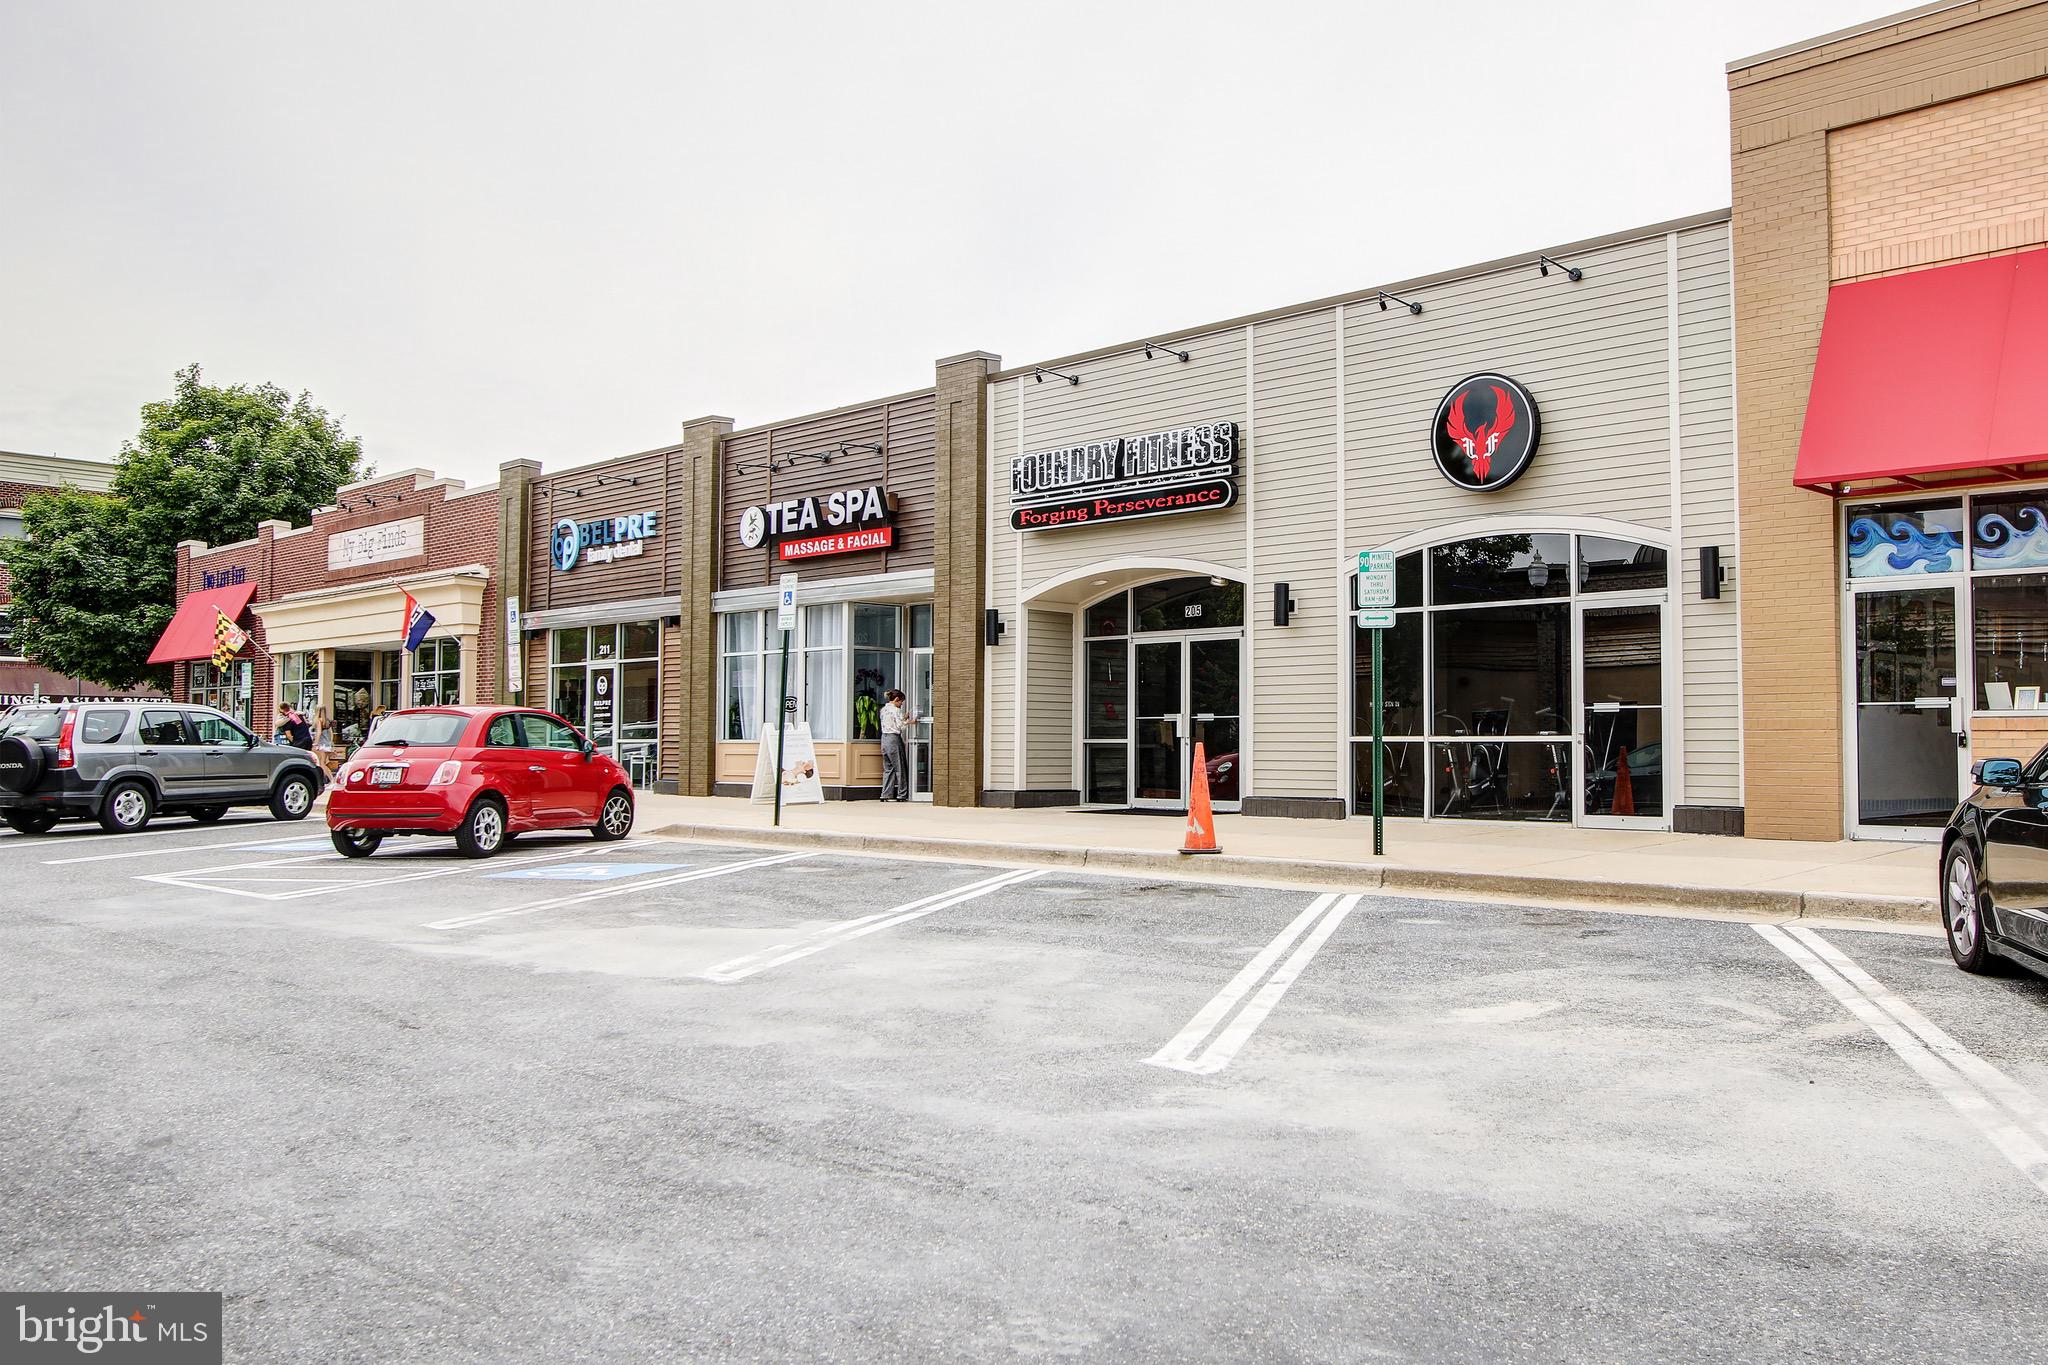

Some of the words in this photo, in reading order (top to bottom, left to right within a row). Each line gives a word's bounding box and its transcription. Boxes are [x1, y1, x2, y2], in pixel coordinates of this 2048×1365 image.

[1010, 438, 1121, 495] FOUNDRY
[1124, 421, 1233, 477] FITNESS
[766, 497, 818, 535] TEA
[827, 486, 884, 526] SPA
[1020, 506, 1088, 526] Forging
[1094, 488, 1221, 517] Perseverance
[579, 511, 657, 547] BELPRE
[784, 538, 835, 557] MASSAGE
[837, 537, 845, 550] &
[847, 531, 887, 548] FACIAL
[342, 537, 355, 562] My
[357, 532, 375, 559] Big
[1360, 556, 1369, 568] 90
[1371, 553, 1391, 561] MINUTE
[1185, 604, 1201, 617] 205
[599, 644, 610, 655] 211
